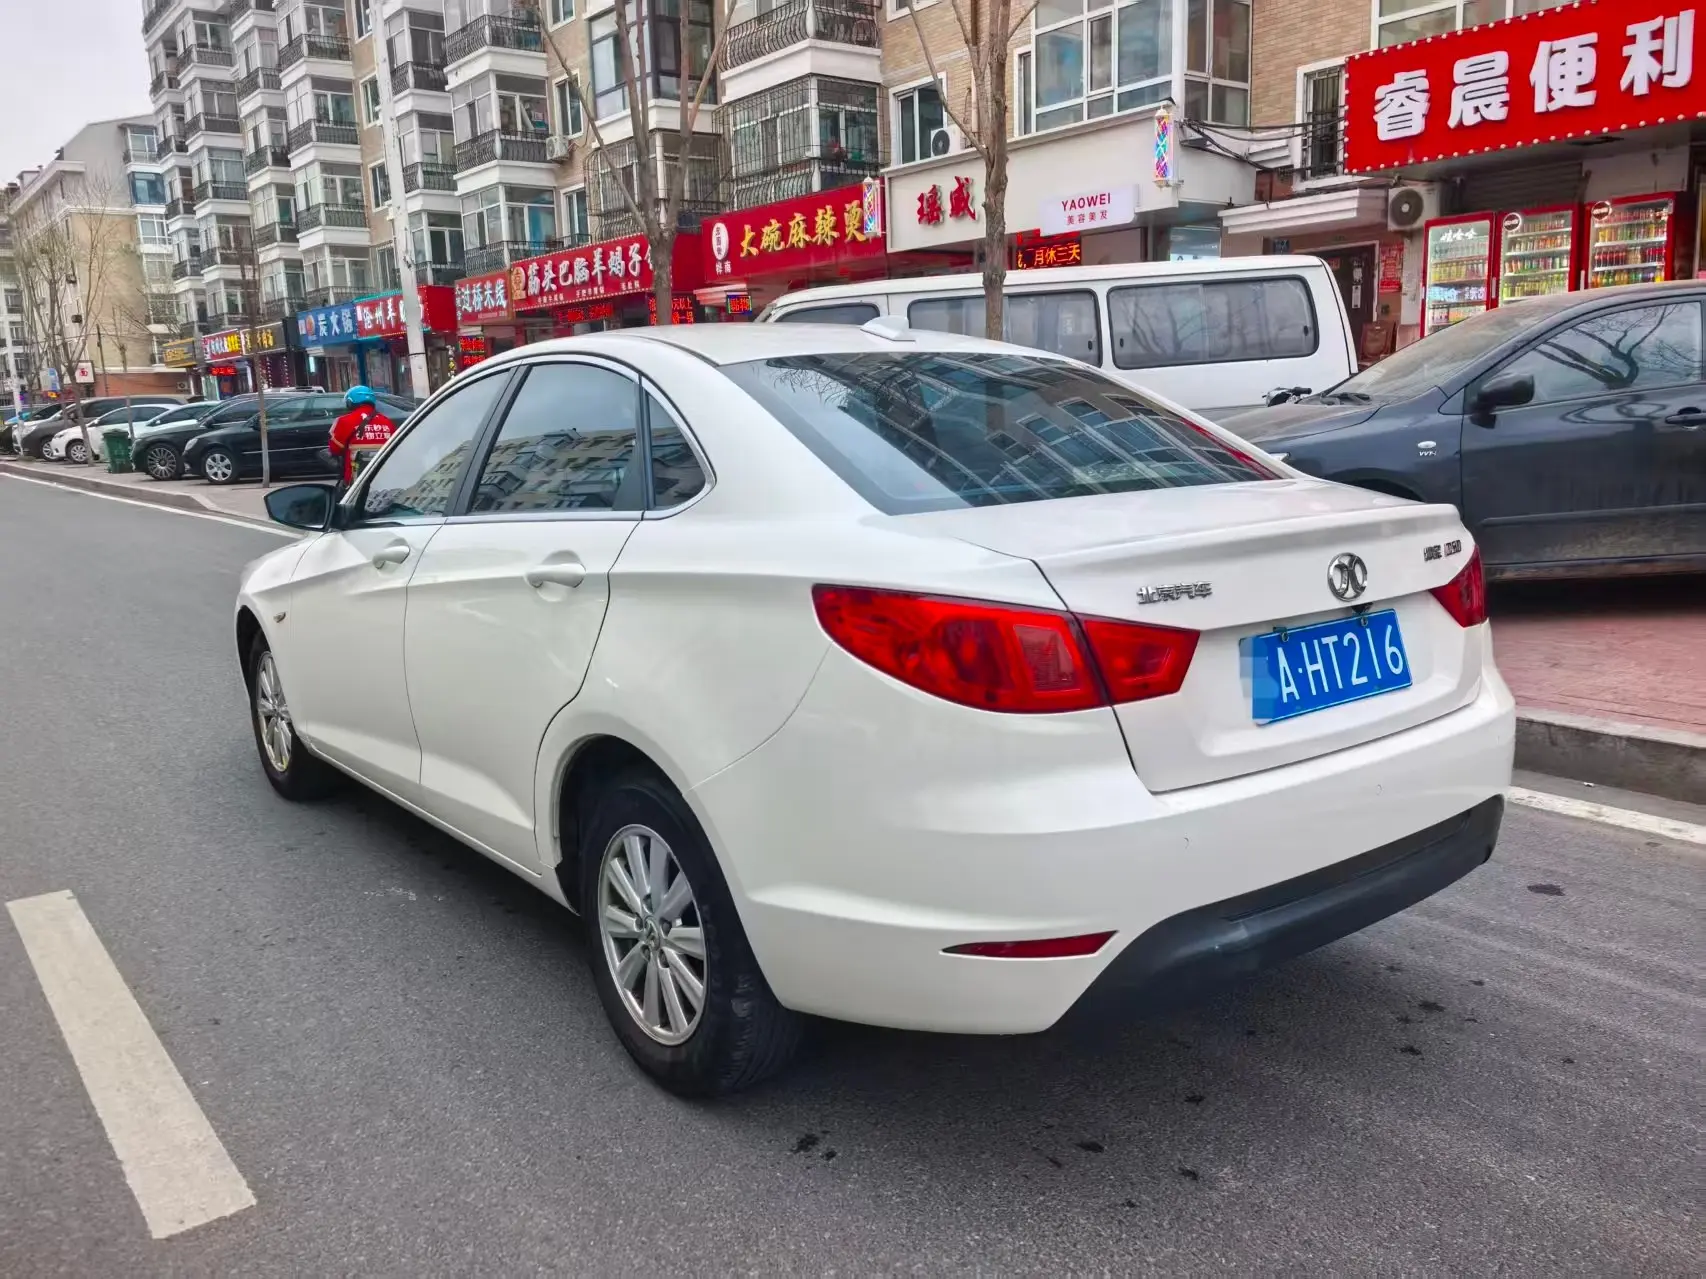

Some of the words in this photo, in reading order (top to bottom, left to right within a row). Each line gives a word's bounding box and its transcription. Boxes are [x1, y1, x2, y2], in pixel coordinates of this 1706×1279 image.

[1373, 9, 1696, 142] 睿晨便利
[1061, 192, 1111, 212] YAOWEI
[1066, 210, 1108, 226] 美容美发
[739, 199, 867, 258] 大碗麻辣烫
[461, 278, 507, 313] 过桥米线
[1136, 579, 1213, 604] 北京汽车
[1255, 625, 1405, 704] A·HT216
